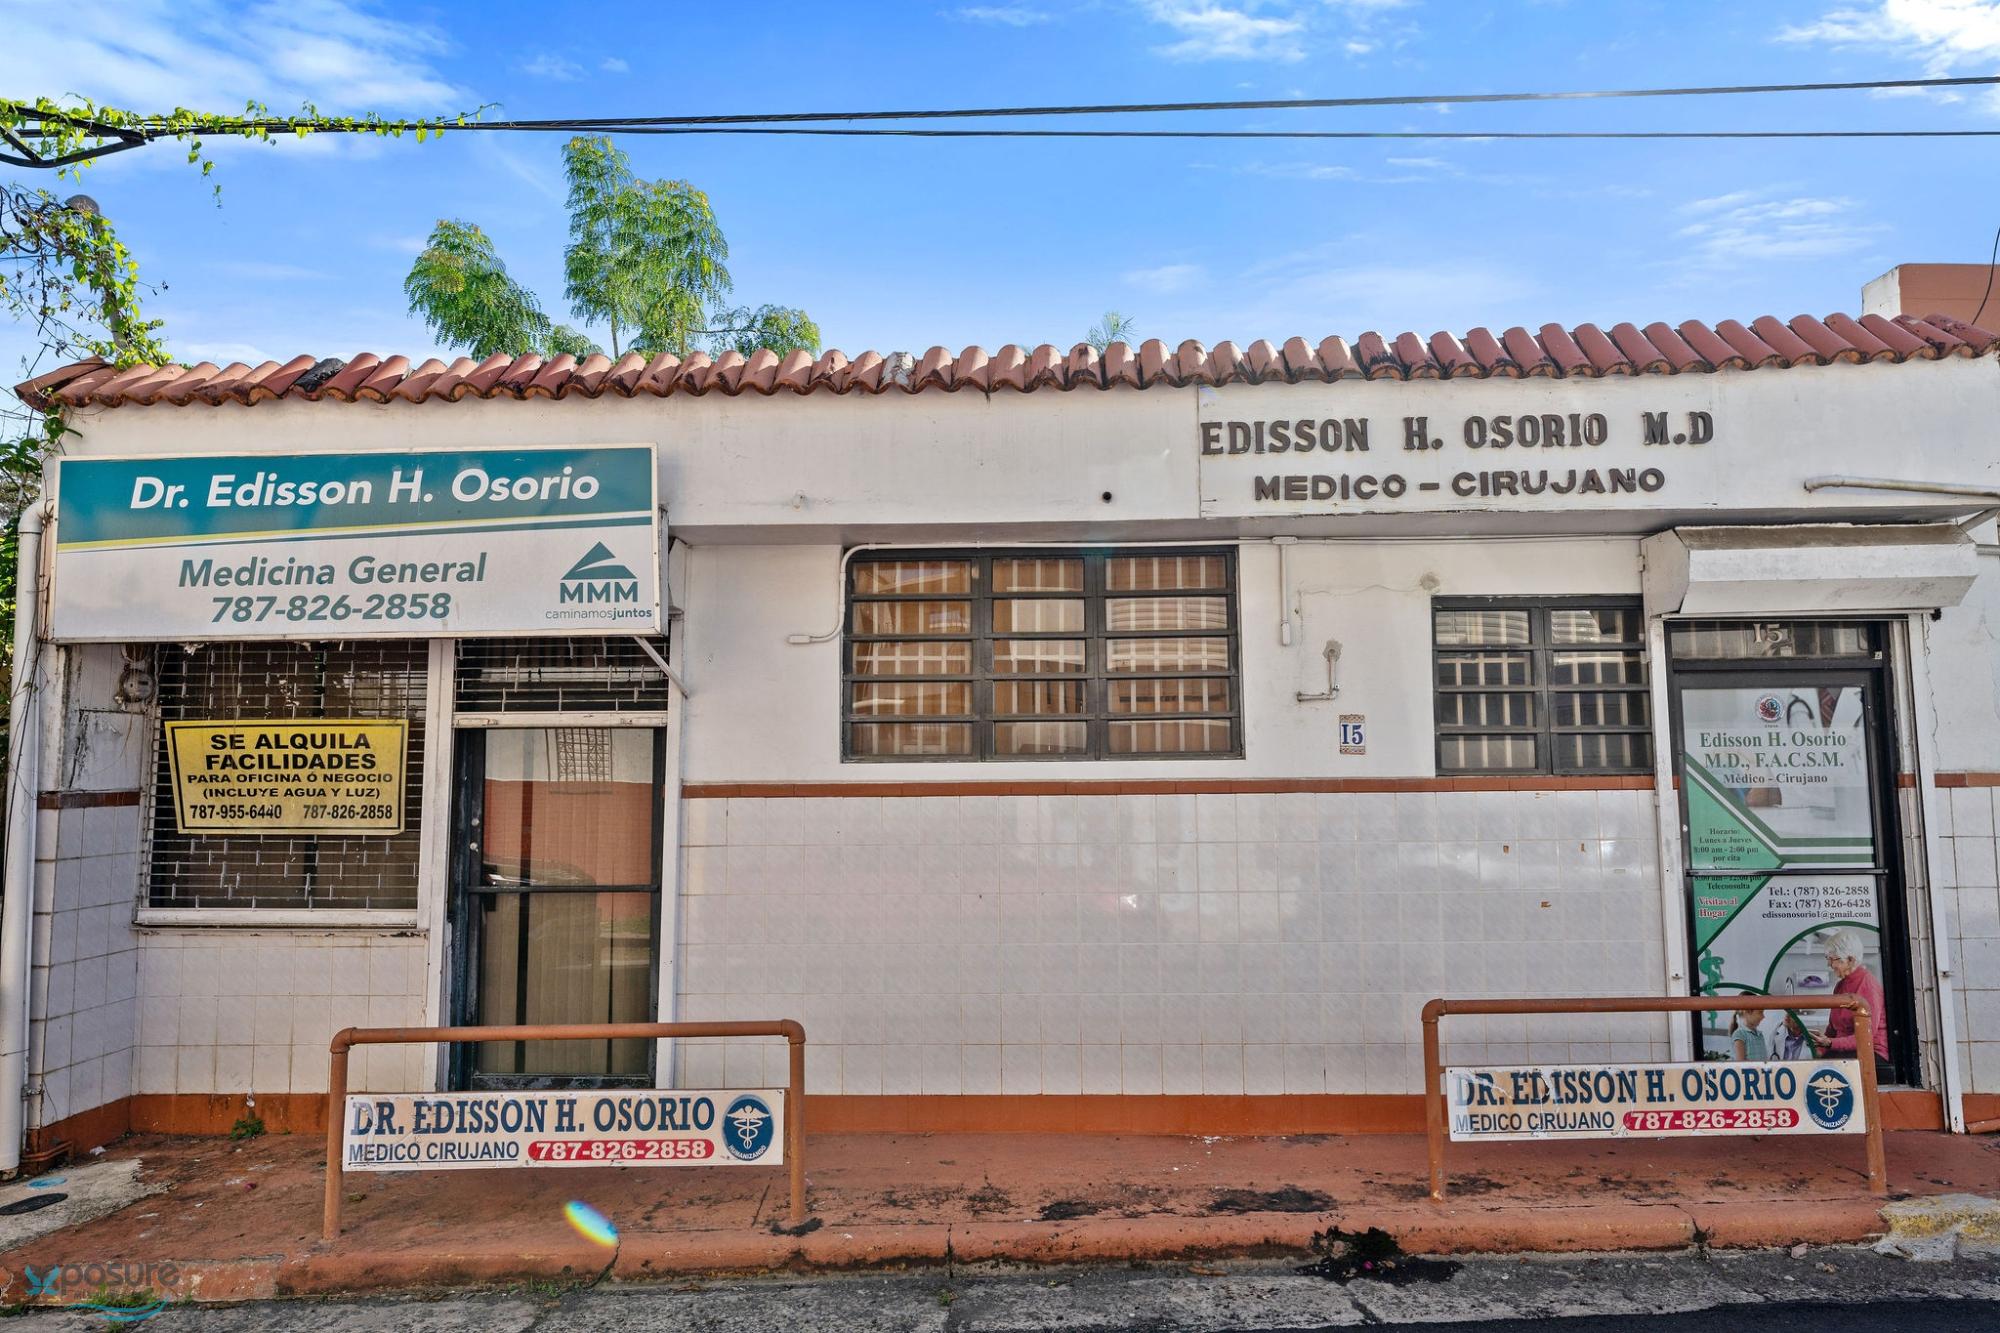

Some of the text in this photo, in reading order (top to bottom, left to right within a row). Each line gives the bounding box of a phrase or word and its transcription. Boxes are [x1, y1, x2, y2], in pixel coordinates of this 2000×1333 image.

[1201, 411, 1714, 455] EDISSON H. OSORIO M.D
[130, 466, 600, 509] Dr. Edisson H. Osorio
[1255, 473, 1407, 500] MEDICO
[1451, 468, 1666, 497] CIRUJANO
[178, 552, 488, 588] Medicina General
[560, 581, 638, 604] MMM
[211, 592, 451, 623] 787-826-2858
[1753, 623, 1783, 643] 15
[210, 733, 370, 750] SE ALQUILA
[1341, 724, 1364, 745] 15
[1700, 731, 1847, 748] Edisson H. Osorio
[206, 753, 376, 770] FACILIDADES
[1704, 752, 1844, 770] M.D., F.A.C.S.M.
[187, 774, 231, 783] PARA
[236, 773, 302, 783] OFICINA
[323, 773, 393, 783] NEGOCIO
[1776, 773, 1828, 786] Cirujano
[203, 787, 380, 799] (INCLUYE AGUA Y LUZ)
[190, 804, 392, 819] 787-955-6440 787-826-2858
[1700, 836, 1721, 844] Lunes
[1729, 836, 1752, 844] Jueves
[1708, 882, 1750, 890] Teleconsulta
[1768, 886, 1869, 897] Tel.: (787) 826-2858
[1699, 897, 1727, 905] Visitas
[1768, 899, 1871, 910] Fax: (787) 826-6428
[1699, 909, 1726, 918] Hogar
[1453, 1068, 1797, 1106] DR. EDISSON H. OSORIO
[351, 1096, 716, 1135] DR. EDISSON H. OSORIO
[1455, 1110, 1792, 1131] MEDICO CIRUJANO 787-826-2858
[350, 1140, 708, 1161] MEDICO CIRUJANO 787-826-2858
